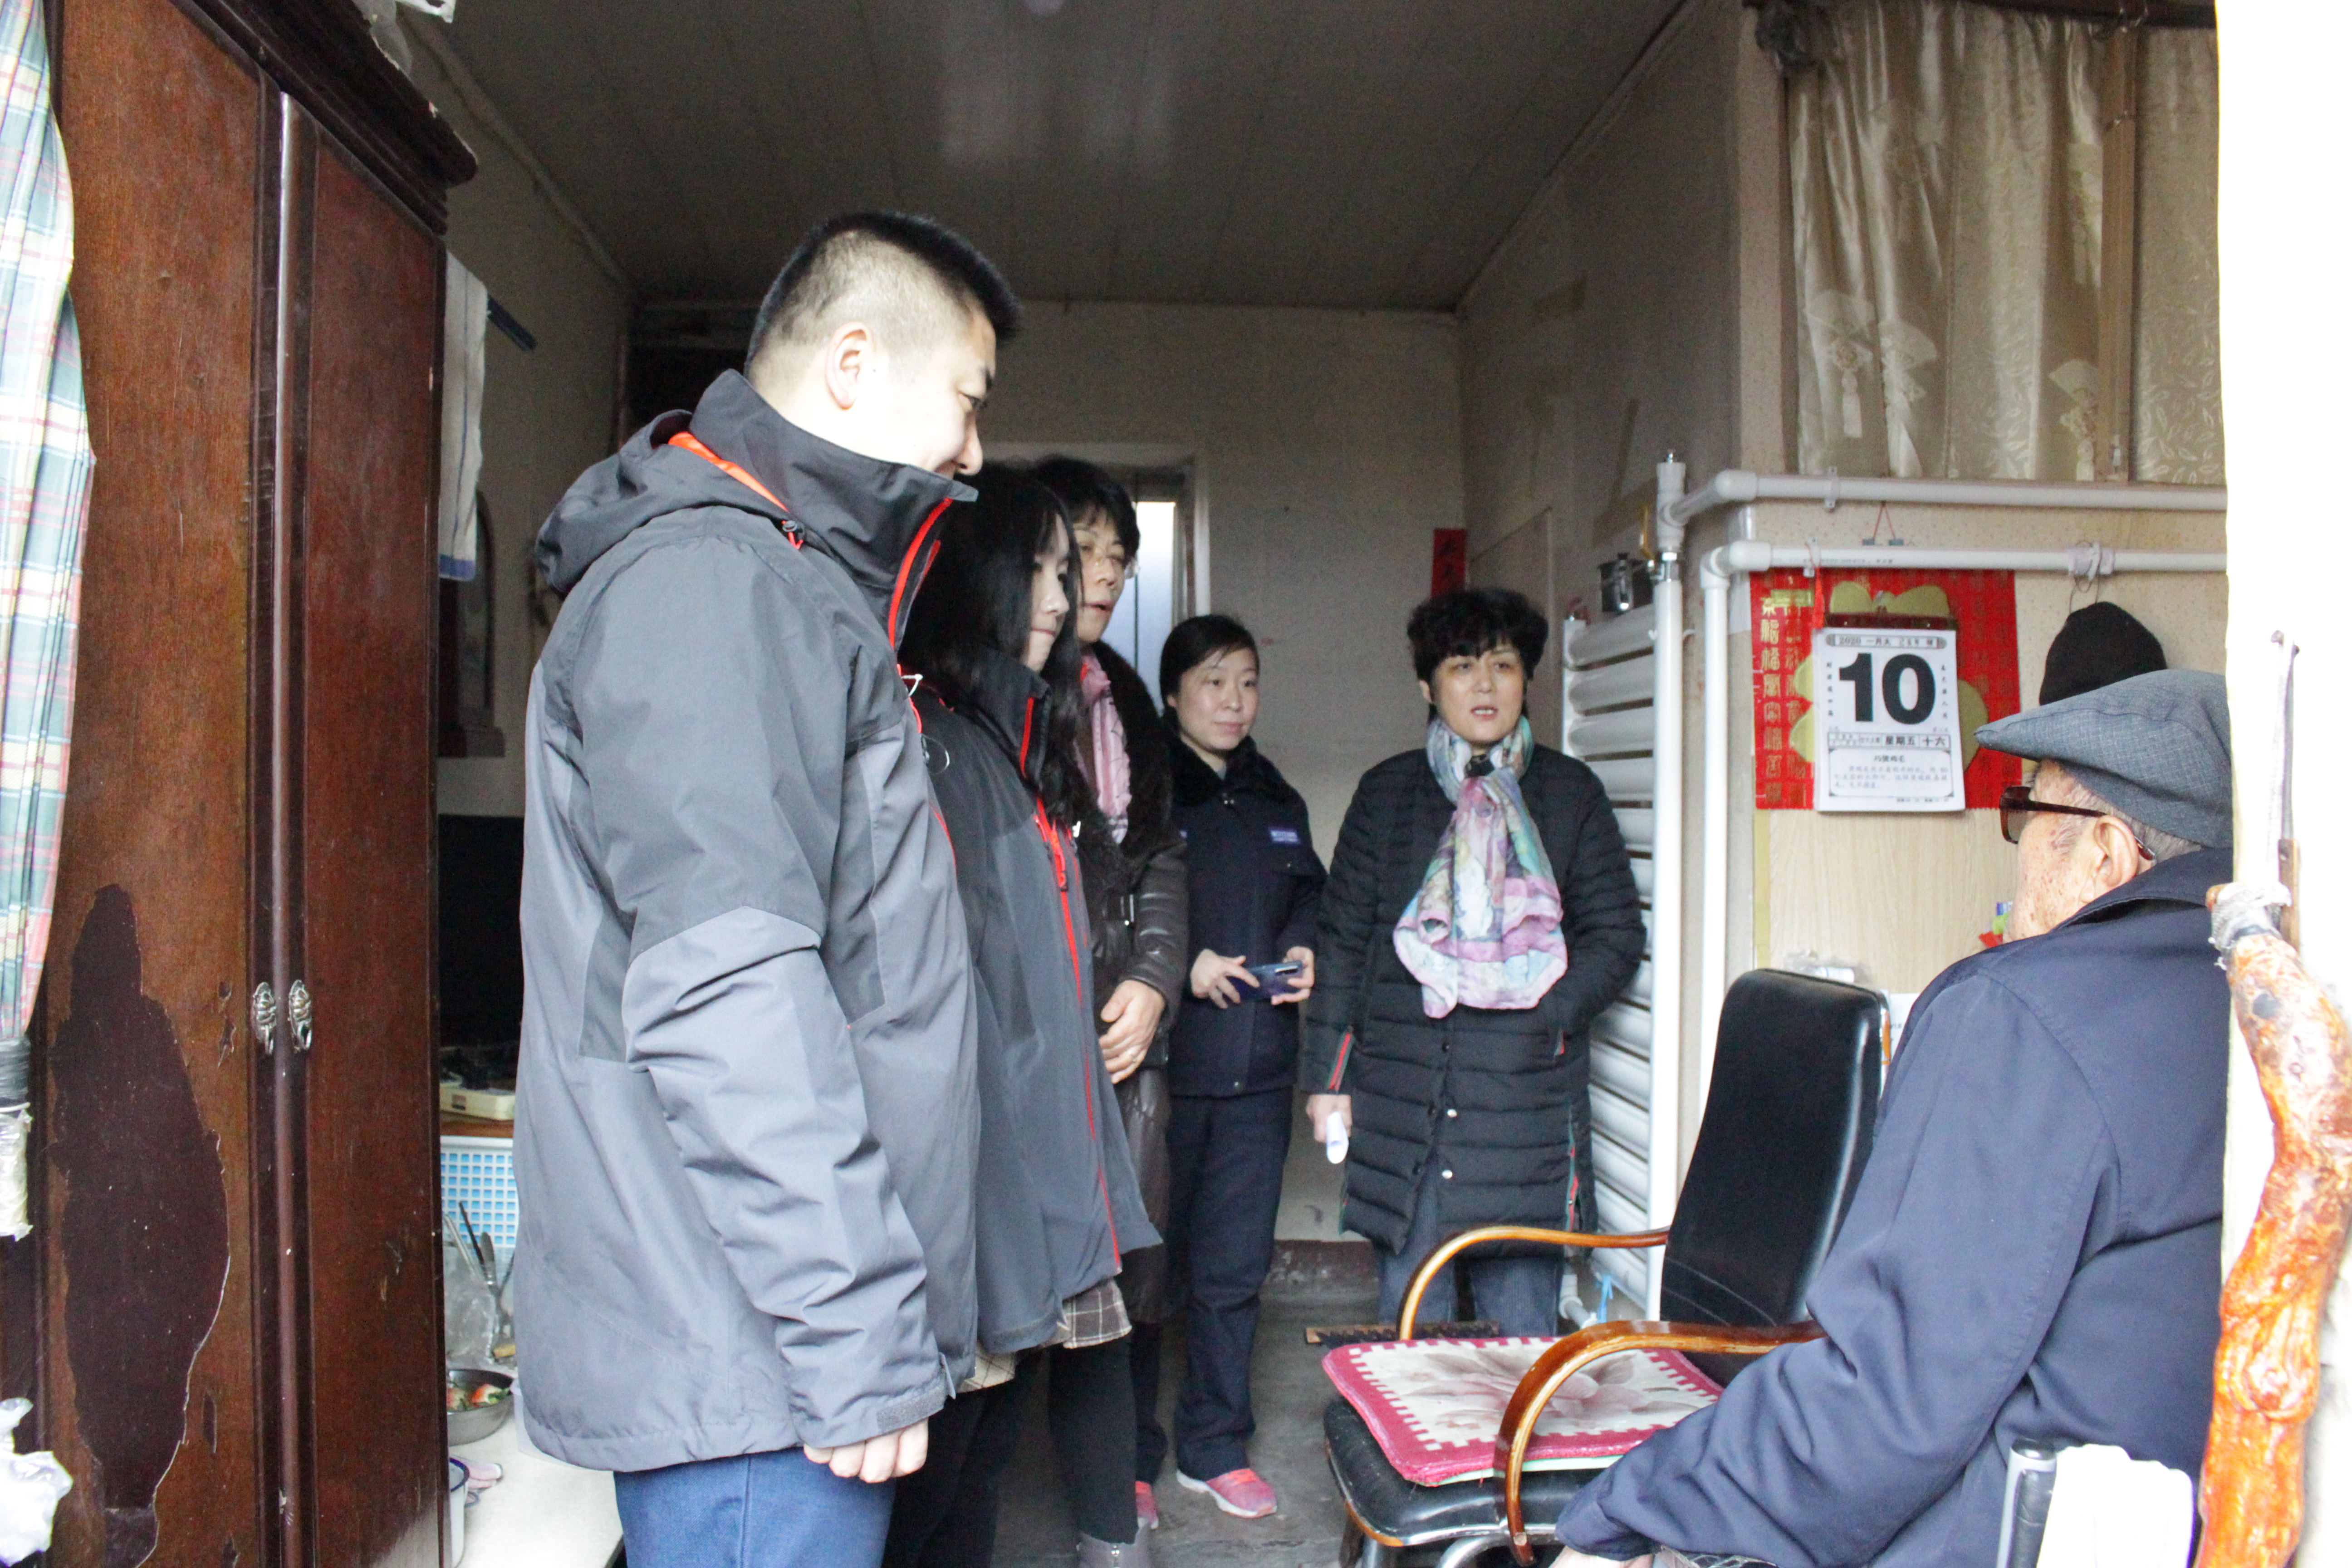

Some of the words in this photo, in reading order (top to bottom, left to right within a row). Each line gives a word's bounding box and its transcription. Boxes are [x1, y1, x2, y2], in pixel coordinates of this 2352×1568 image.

[1839, 636, 1862, 646] 2020
[1839, 652, 1936, 725] 10
[1885, 735, 1916, 746] 星期五
[1922, 736, 1946, 746] 十六
